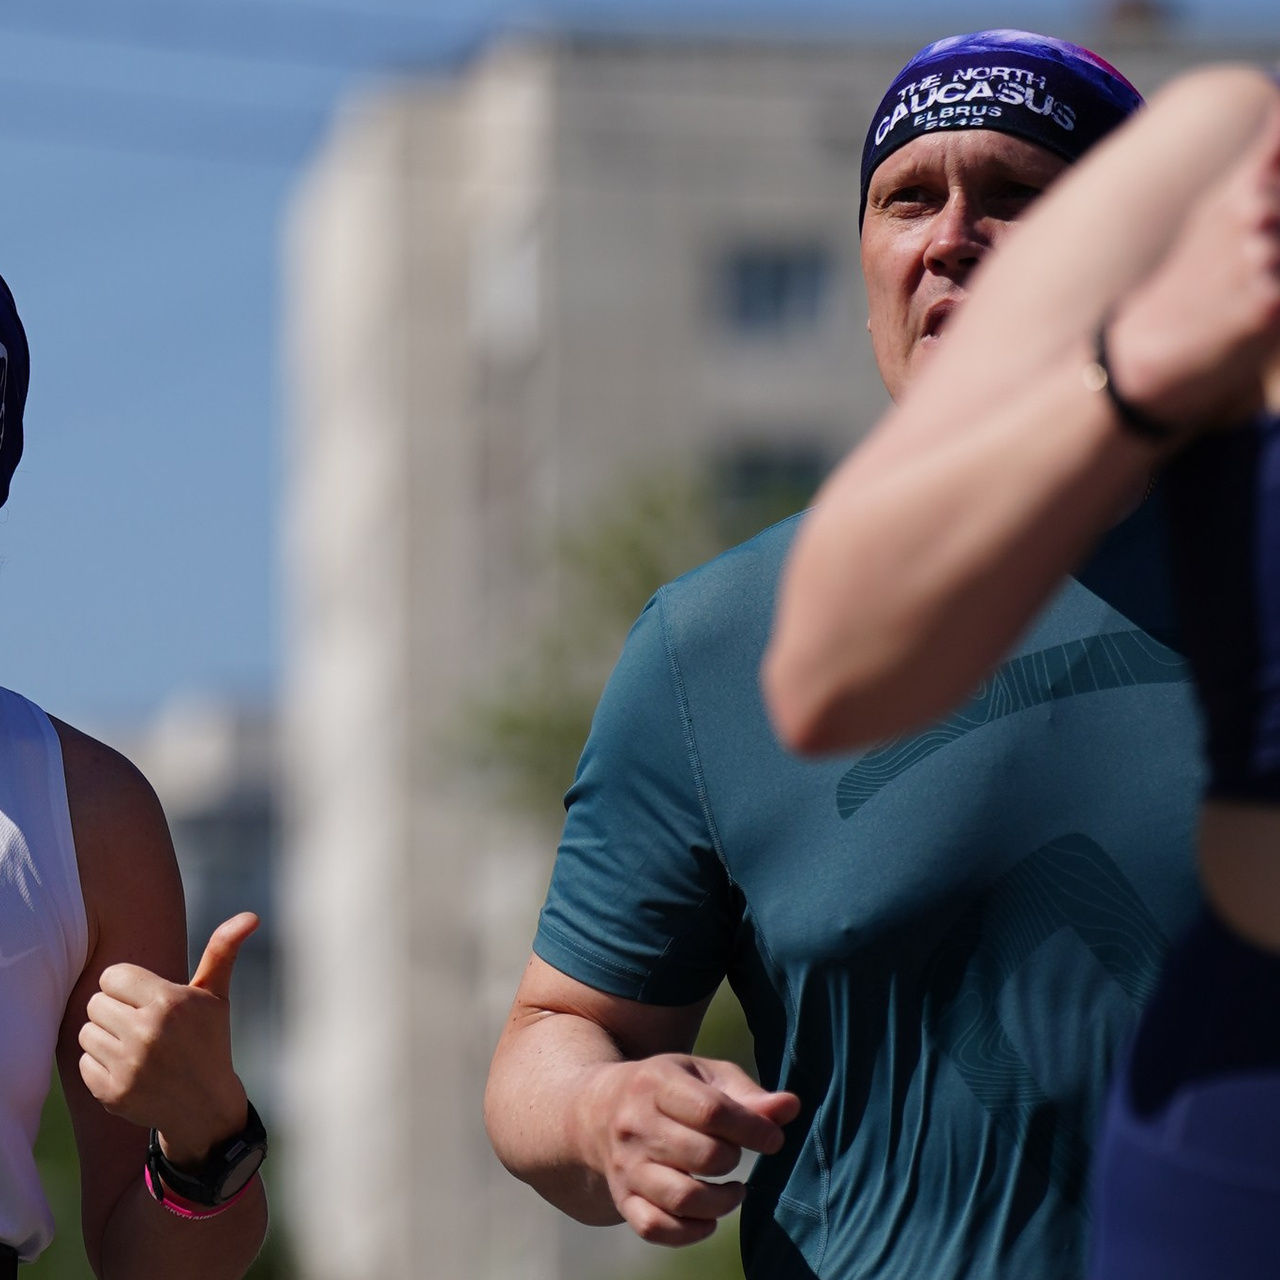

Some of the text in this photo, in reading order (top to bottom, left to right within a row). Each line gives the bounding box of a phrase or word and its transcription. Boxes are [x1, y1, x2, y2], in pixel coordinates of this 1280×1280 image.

[898, 66, 1046, 101] THE NORTH
[875, 80, 1077, 146] CAUCASUS
[913, 105, 1003, 127] ELBRUS
